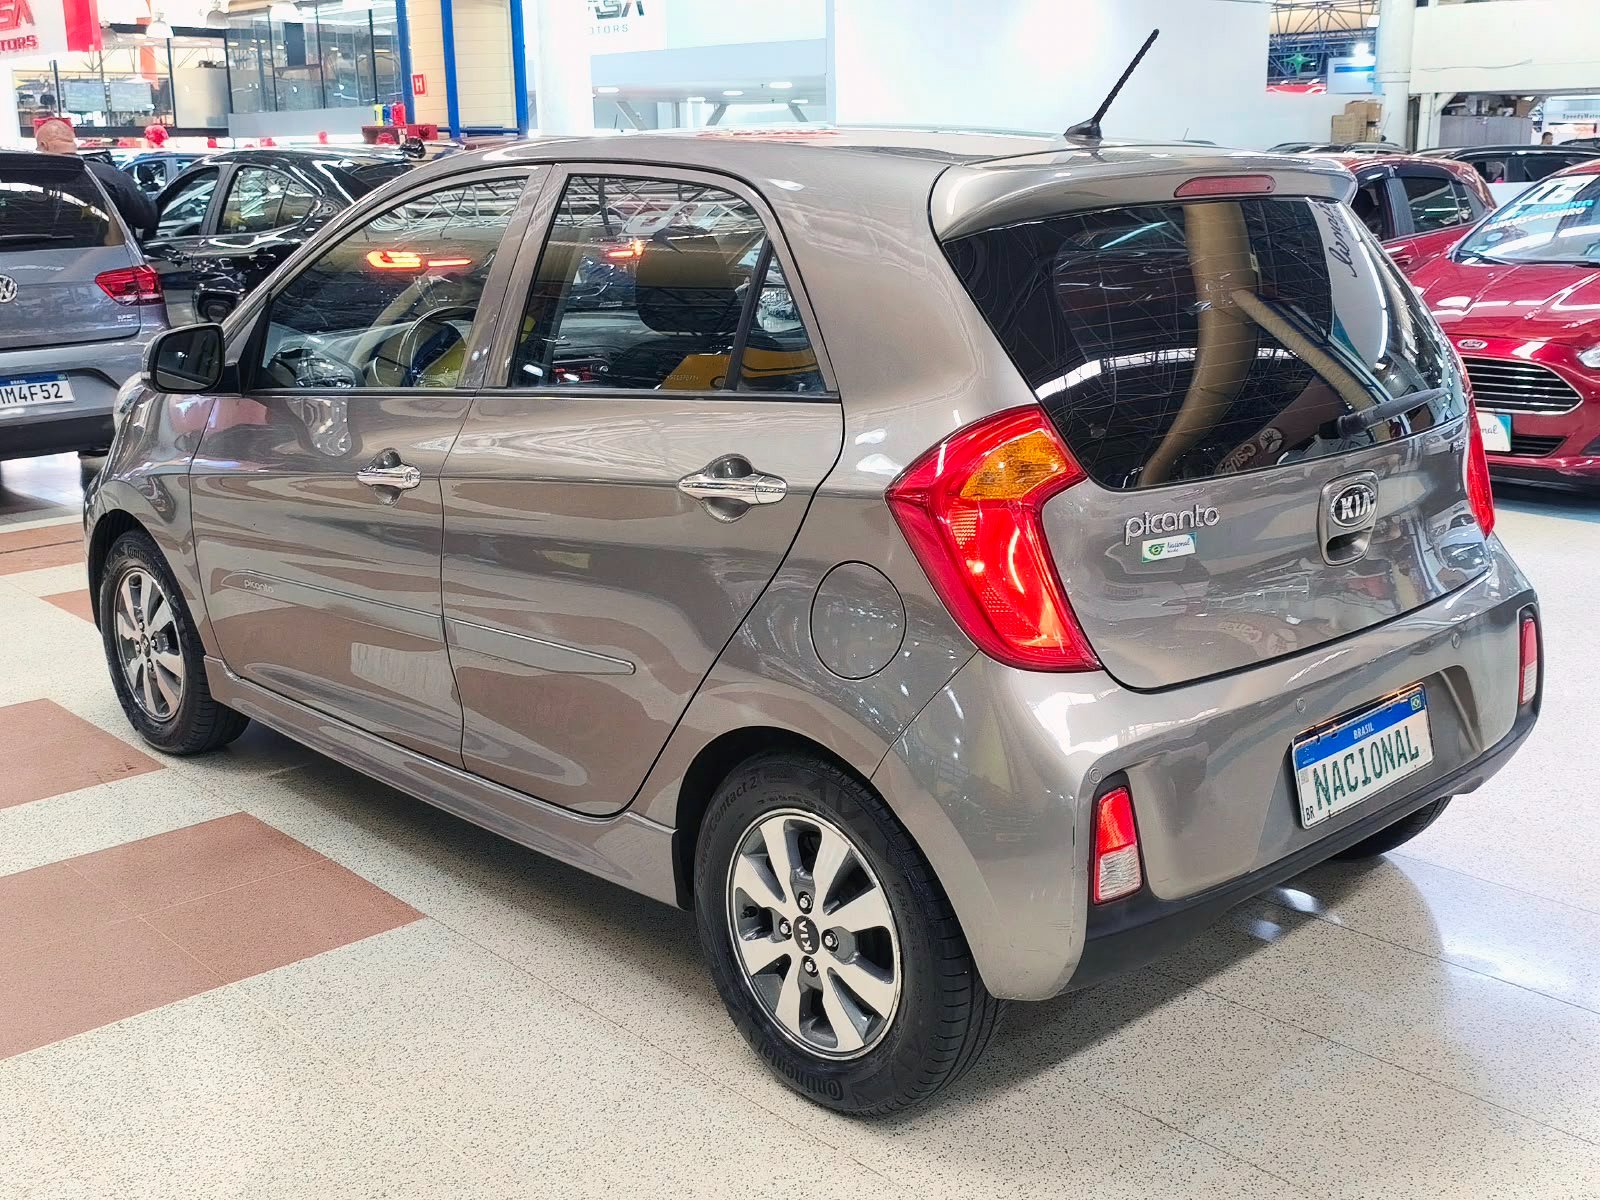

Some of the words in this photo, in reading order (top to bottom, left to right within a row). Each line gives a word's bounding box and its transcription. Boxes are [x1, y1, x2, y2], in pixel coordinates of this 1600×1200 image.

[1340, 491, 1372, 520] KIA
[1124, 504, 1220, 546] picanto
[1353, 722, 1375, 740] BRASIL
[1313, 725, 1420, 811] NACIONAL
[1306, 805, 1316, 821] BR
[798, 920, 813, 950] KIA
